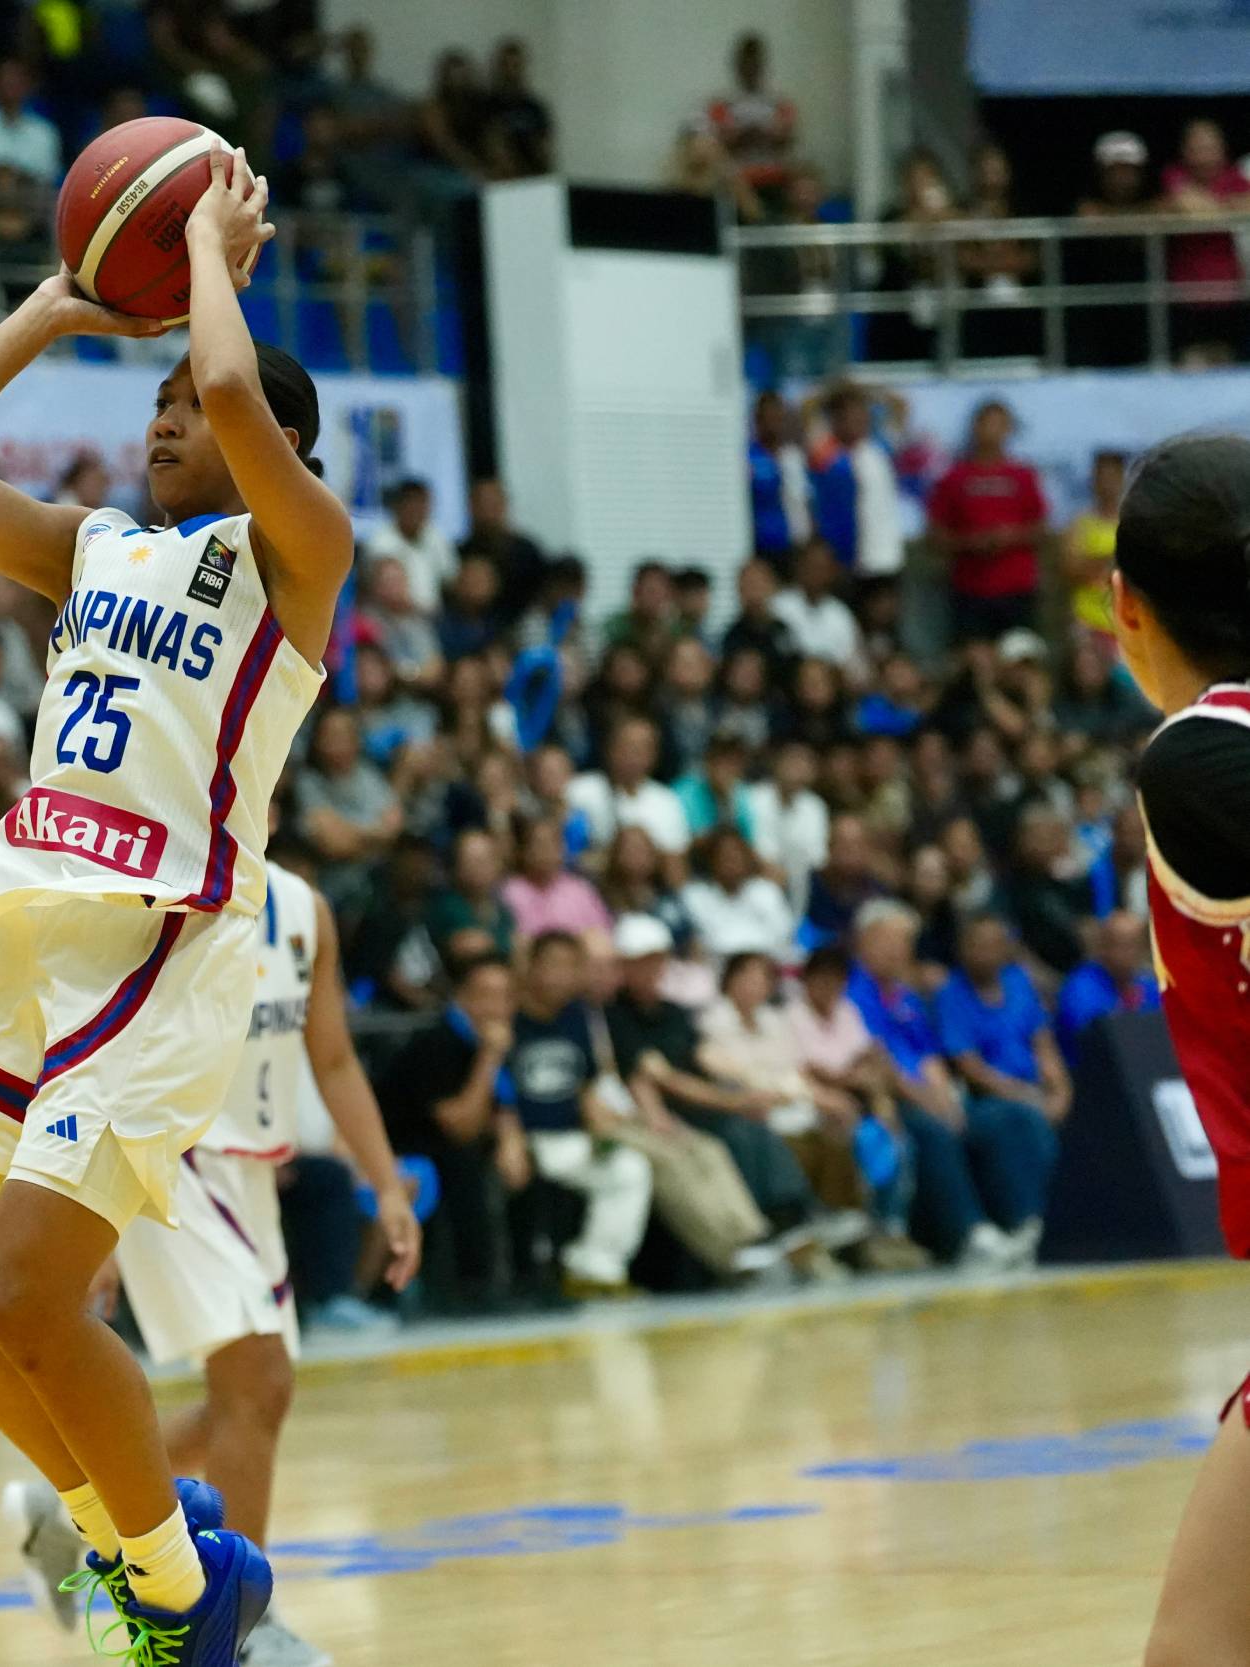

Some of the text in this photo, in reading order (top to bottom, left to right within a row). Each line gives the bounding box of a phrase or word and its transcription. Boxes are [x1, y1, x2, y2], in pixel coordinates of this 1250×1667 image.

[116, 179, 149, 215] BG4550
[198, 570, 224, 590] FIBA
[56, 670, 141, 774] 25
[14, 797, 152, 870] Akari
